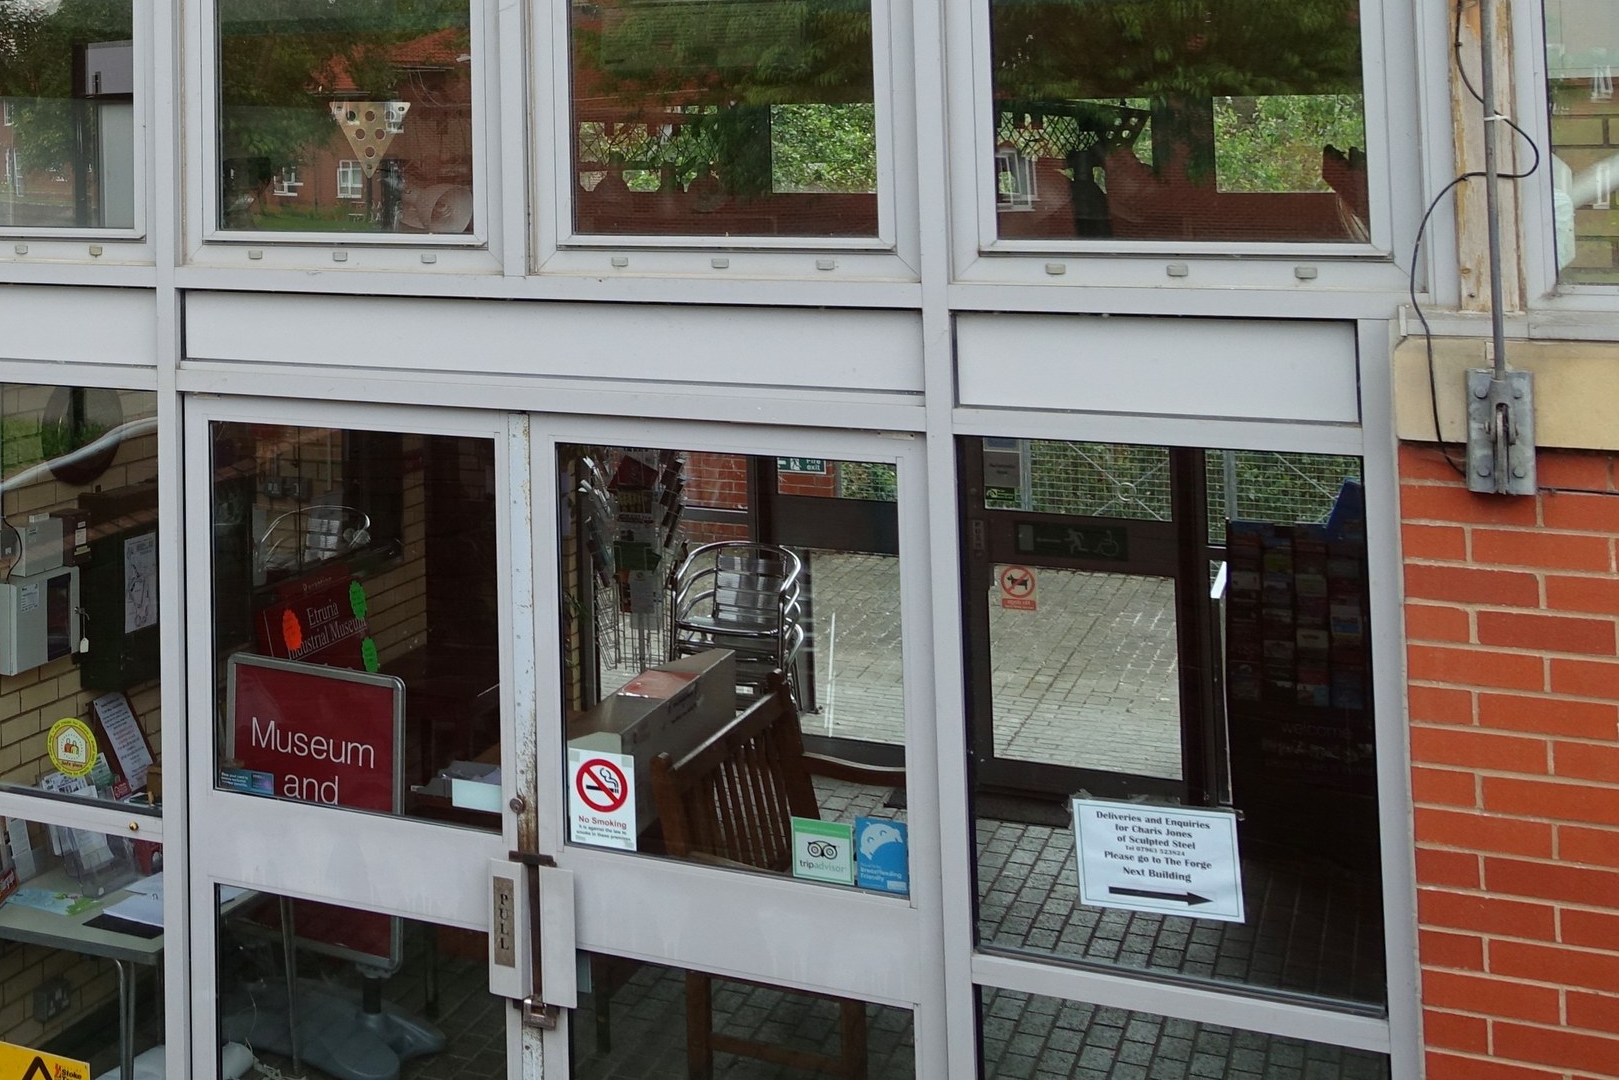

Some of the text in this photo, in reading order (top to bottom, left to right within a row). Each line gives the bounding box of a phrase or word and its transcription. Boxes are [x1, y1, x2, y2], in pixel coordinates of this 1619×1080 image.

[306, 599, 339, 627] Etruria
[288, 624, 330, 660] Industrial
[329, 617, 367, 642] Museum
[251, 716, 375, 769] Museum
[284, 774, 339, 806] and
[578, 815, 627, 829] No Smoking
[1096, 811, 1210, 830] Deliveries and Enquiries
[1115, 824, 1192, 838] for Charis Jones
[1129, 836, 1169, 847] Sculpted
[1172, 840, 1196, 850] Steel
[800, 860, 844, 873] tripadvisor
[1104, 850, 1134, 861] Please
[1138, 855, 1149, 863] go
[1164, 857, 1181, 866] The
[1185, 859, 1212, 870] Forge
[1123, 866, 1192, 883] Next Building
[500, 893, 509, 951] PULL
